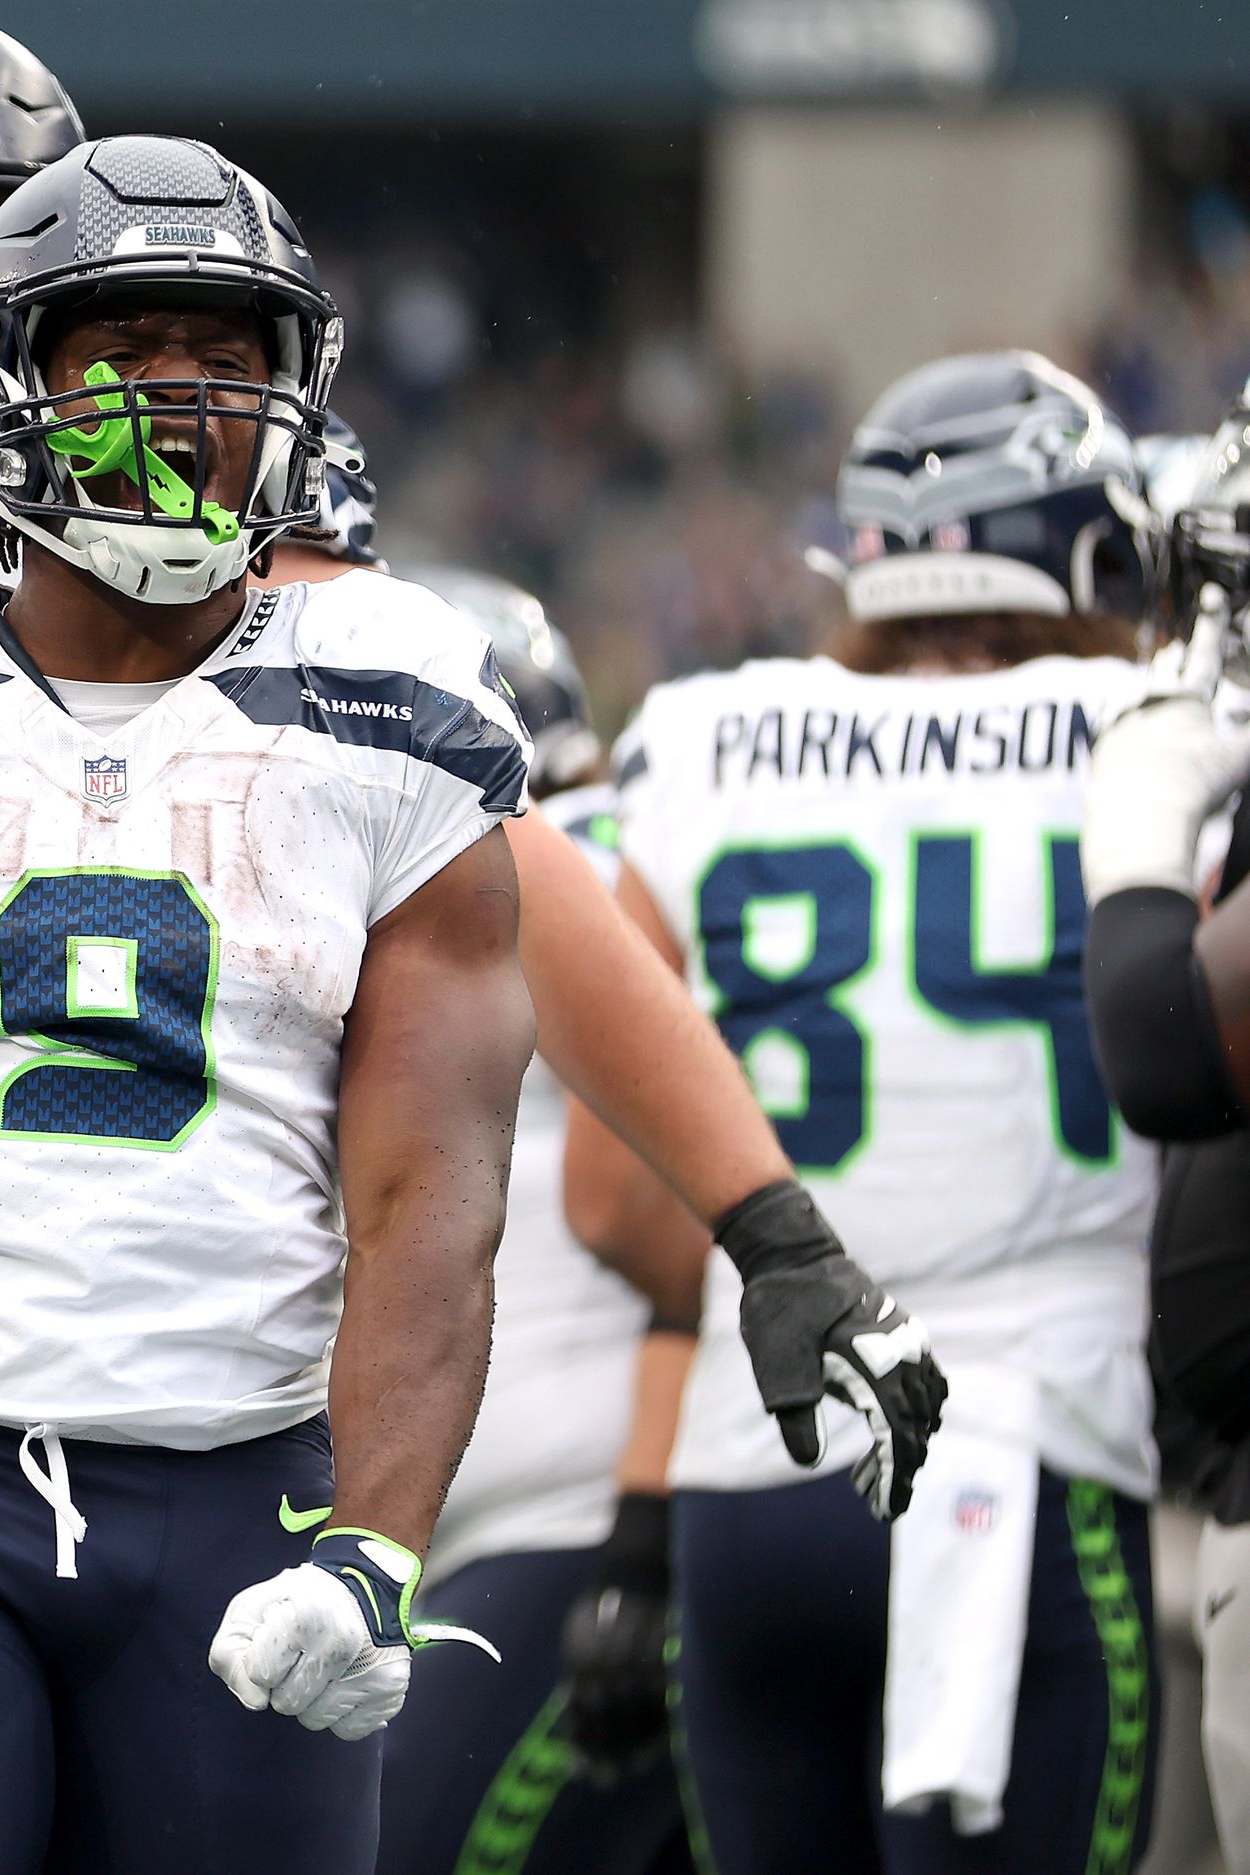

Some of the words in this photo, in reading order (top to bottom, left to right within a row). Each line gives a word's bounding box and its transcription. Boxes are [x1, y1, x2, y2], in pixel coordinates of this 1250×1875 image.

[145, 226, 216, 248] SEAHAWKS
[300, 688, 414, 721] SAHAWKS
[89, 774, 123, 796] NFL
[693, 825, 1120, 1180] 84
